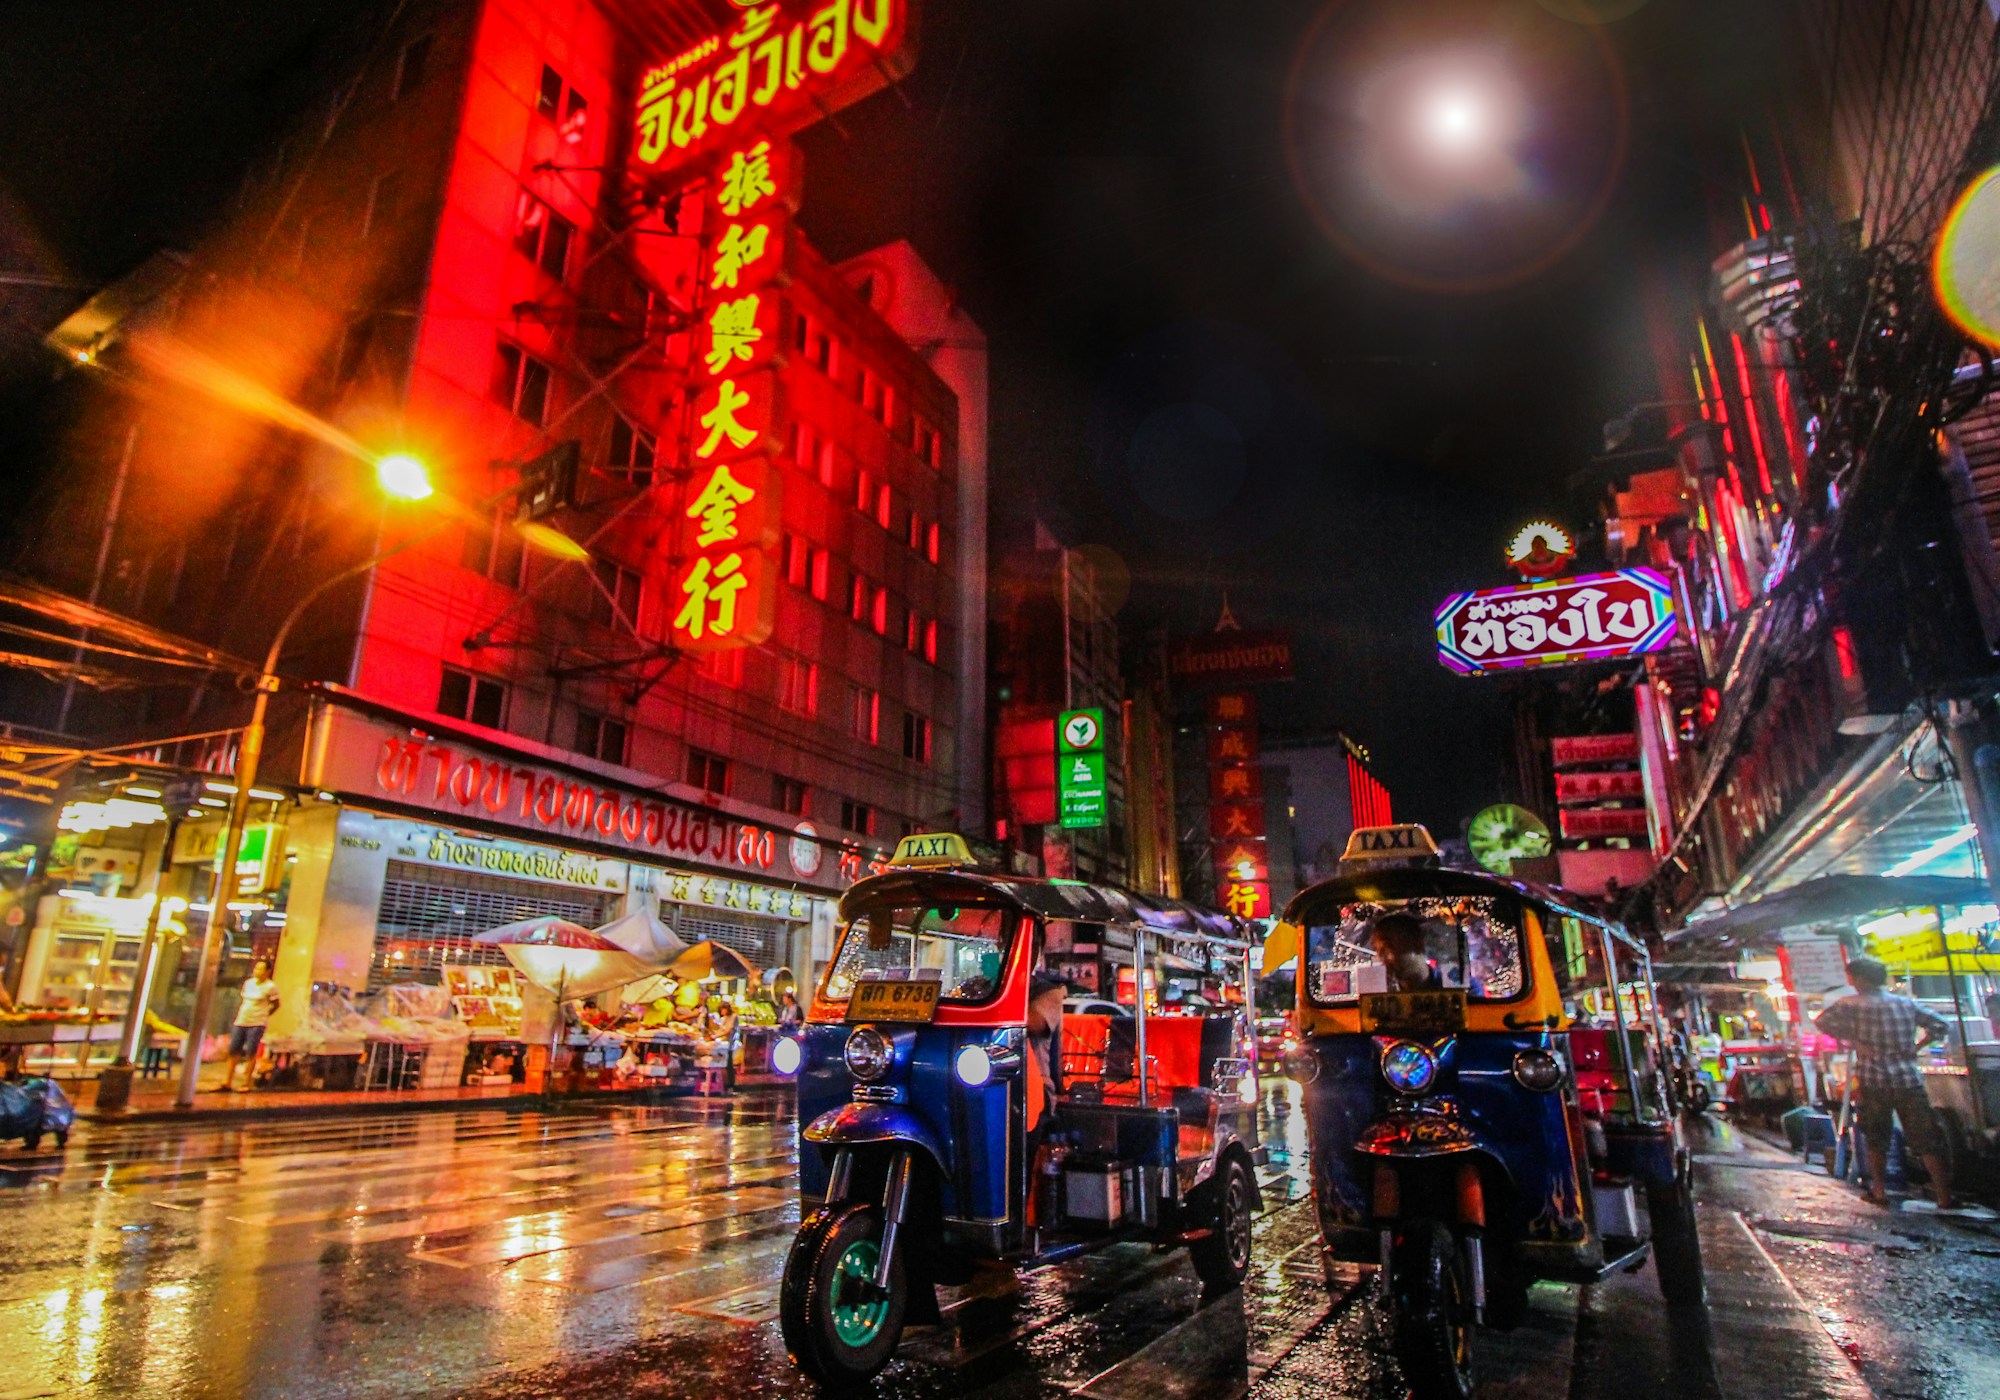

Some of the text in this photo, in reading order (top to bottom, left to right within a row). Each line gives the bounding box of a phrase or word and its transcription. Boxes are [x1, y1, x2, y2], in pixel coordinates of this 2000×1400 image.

[905, 838, 949, 857] TAXI
[1356, 829, 1414, 850] TAXI
[893, 985, 934, 1002] 6738
